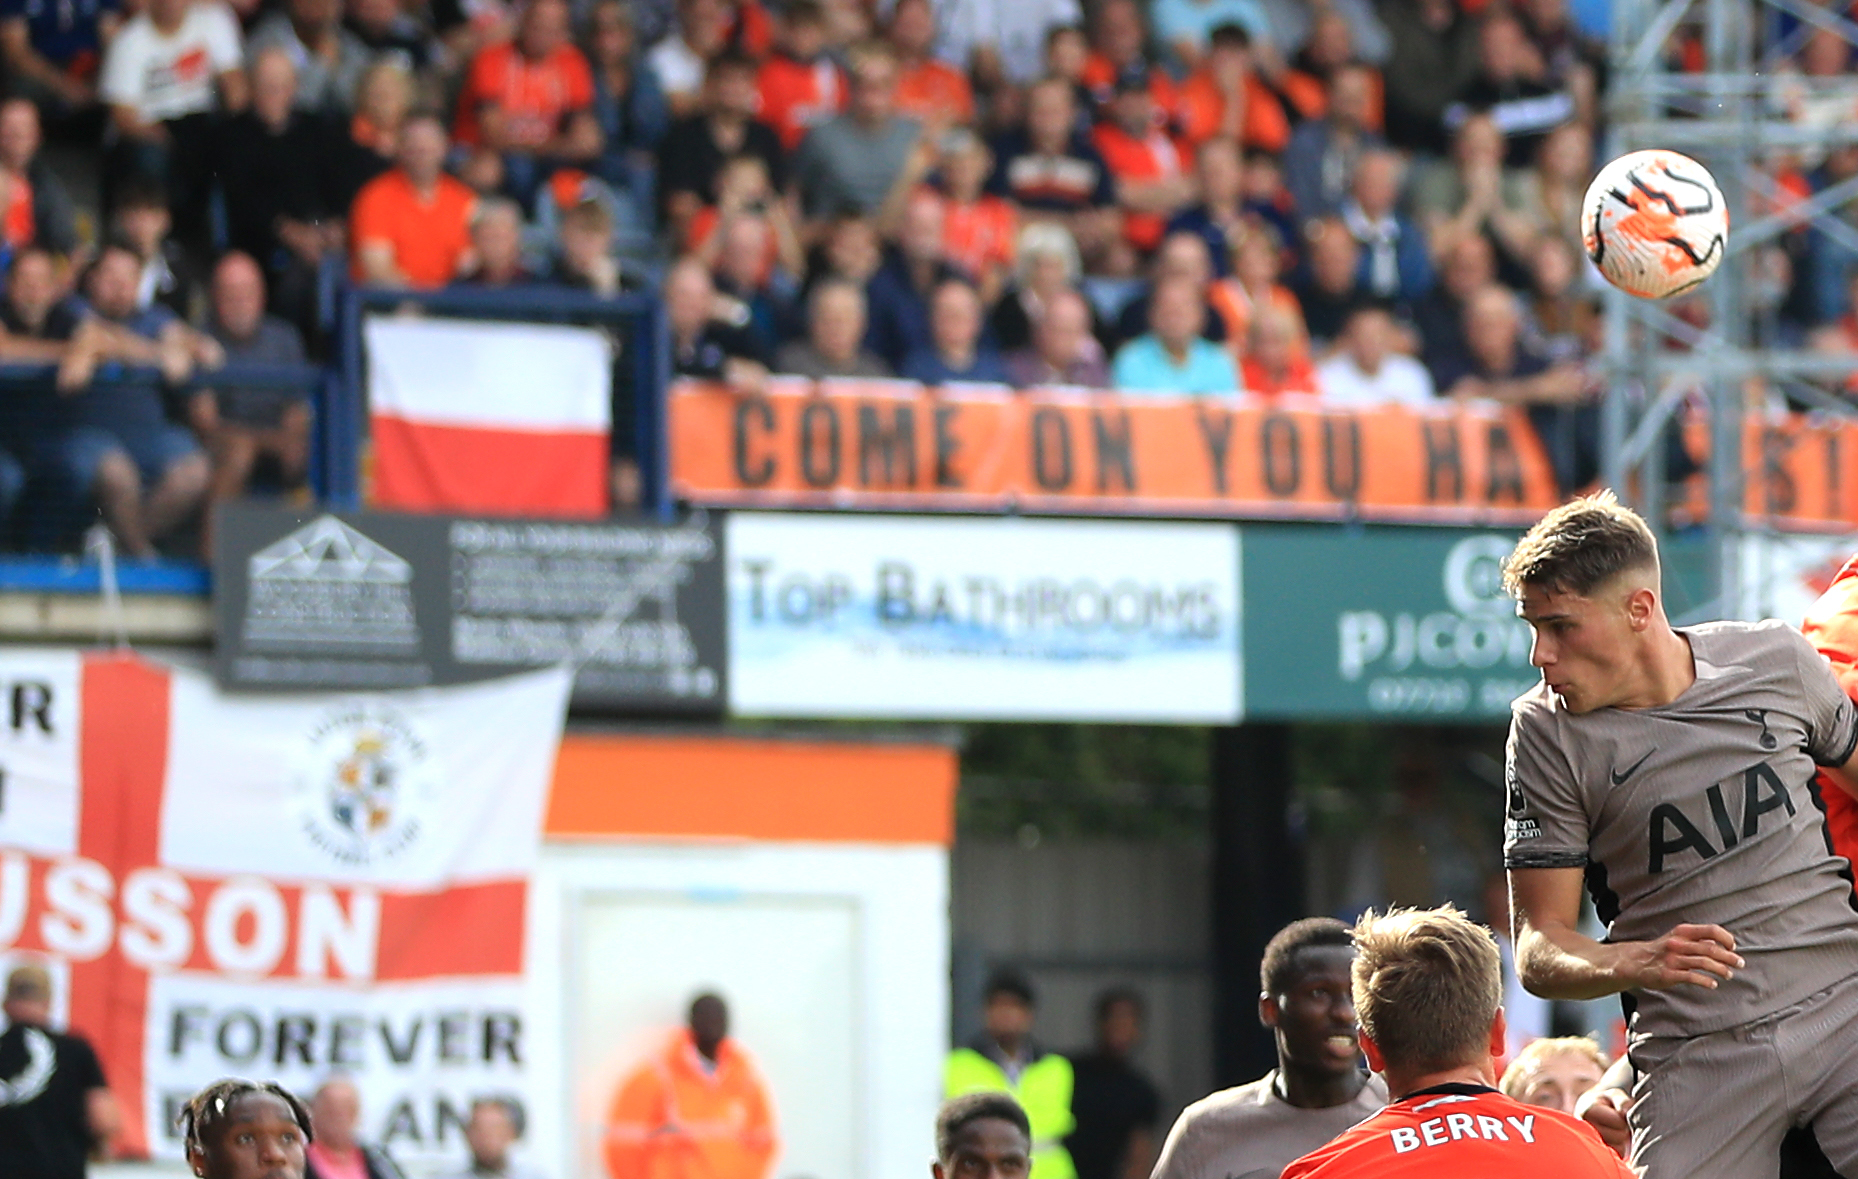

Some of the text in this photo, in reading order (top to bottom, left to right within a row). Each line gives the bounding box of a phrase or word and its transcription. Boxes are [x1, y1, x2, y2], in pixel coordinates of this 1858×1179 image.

[733, 402, 1524, 502] COME ON YOU HA
[1648, 762, 1796, 873] AIA
[169, 1005, 524, 1066] FOREVER
[1391, 1112, 1536, 1154] BERRY
